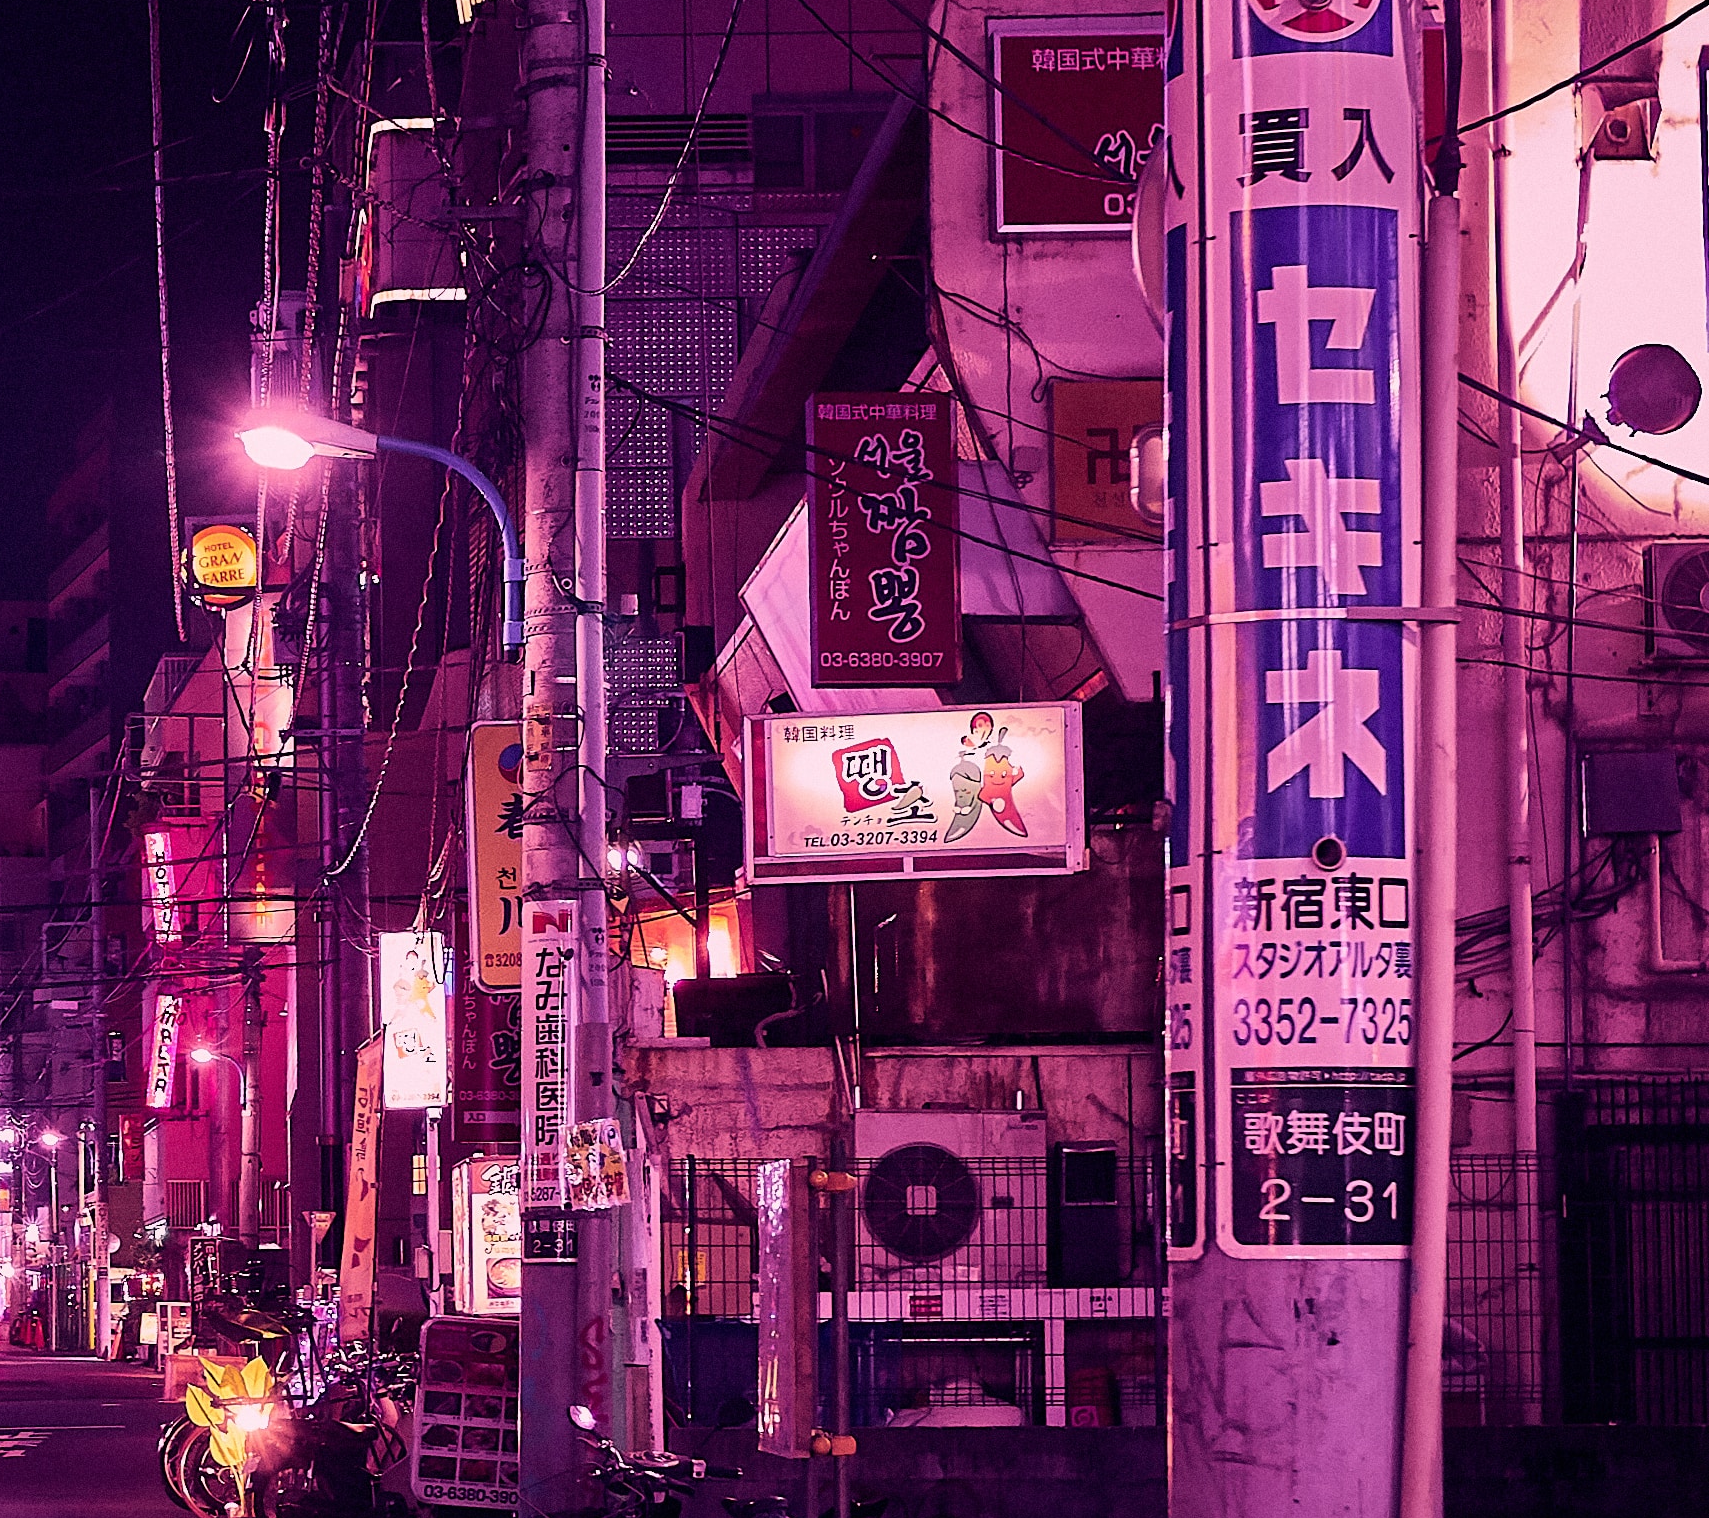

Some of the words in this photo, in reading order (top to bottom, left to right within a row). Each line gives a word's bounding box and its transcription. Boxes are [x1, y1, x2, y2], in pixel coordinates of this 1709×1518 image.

[1236, 105, 1395, 188] 買入
[816, 403, 938, 422] 韓国式中華料理
[203, 541, 235, 553] HOTEL
[1257, 264, 1389, 799] セキネ
[198, 551, 244, 569] GRAN
[202, 568, 245, 585] FARRE
[819, 651, 945, 669] 03-6380-3907
[783, 723, 856, 744] 韓国料理
[1232, 871, 1411, 932] 新宿東口
[1232, 941, 1413, 980] スタジオアルタ裏
[1232, 996, 1413, 1048] 3352-7325
[1243, 1109, 1407, 1157] 歌舞伎町
[1258, 1178, 1399, 1225] 2-31
